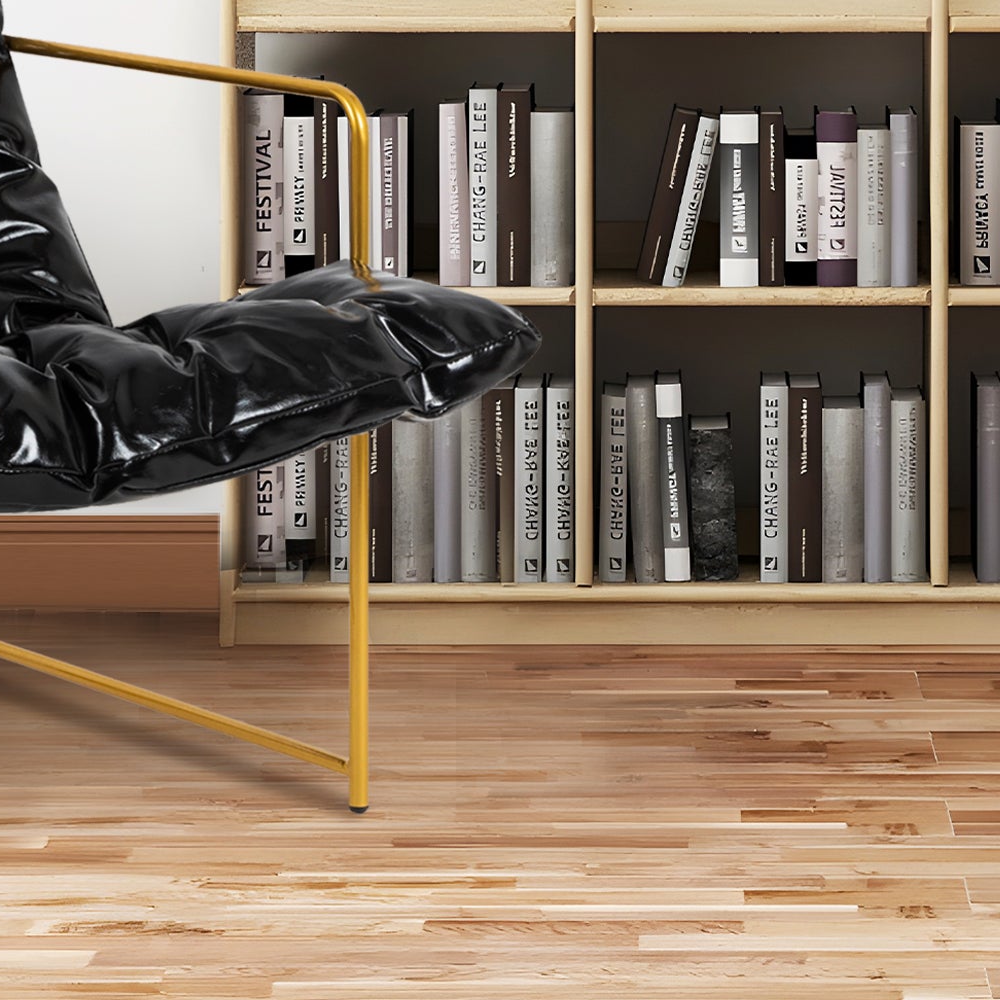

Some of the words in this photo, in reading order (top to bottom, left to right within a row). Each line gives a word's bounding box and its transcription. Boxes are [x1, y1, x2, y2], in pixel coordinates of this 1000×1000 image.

[472, 102, 488, 133] LEE
[256, 129, 273, 234] FESTIVAL
[472, 141, 488, 243] CHANG-RAE
[764, 399, 779, 428] LEE
[764, 438, 779, 539] CHANG-RAE
